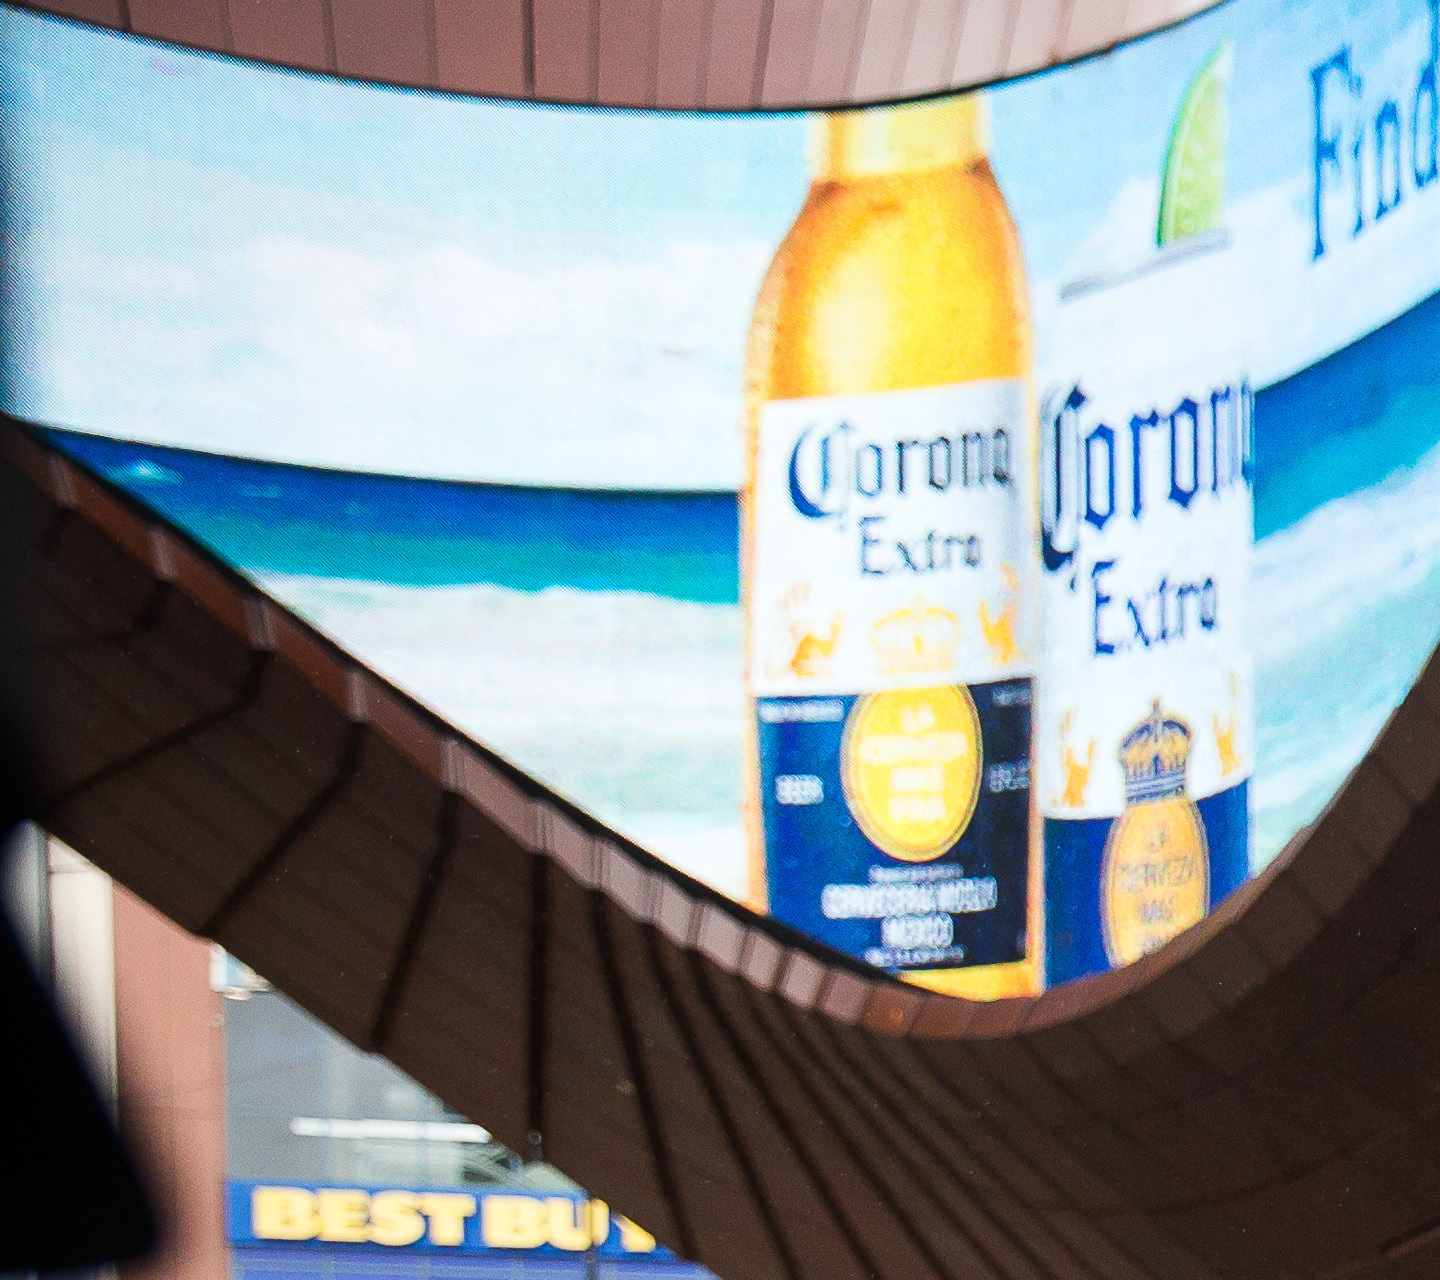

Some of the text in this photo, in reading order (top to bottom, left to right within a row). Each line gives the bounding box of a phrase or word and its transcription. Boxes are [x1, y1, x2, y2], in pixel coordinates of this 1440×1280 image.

[1309, 0, 1440, 264] Find
[788, 418, 1015, 526] Corona
[857, 514, 980, 582] Extra
[1092, 556, 1218, 659] Extra
[251, 1185, 477, 1246] BEST
